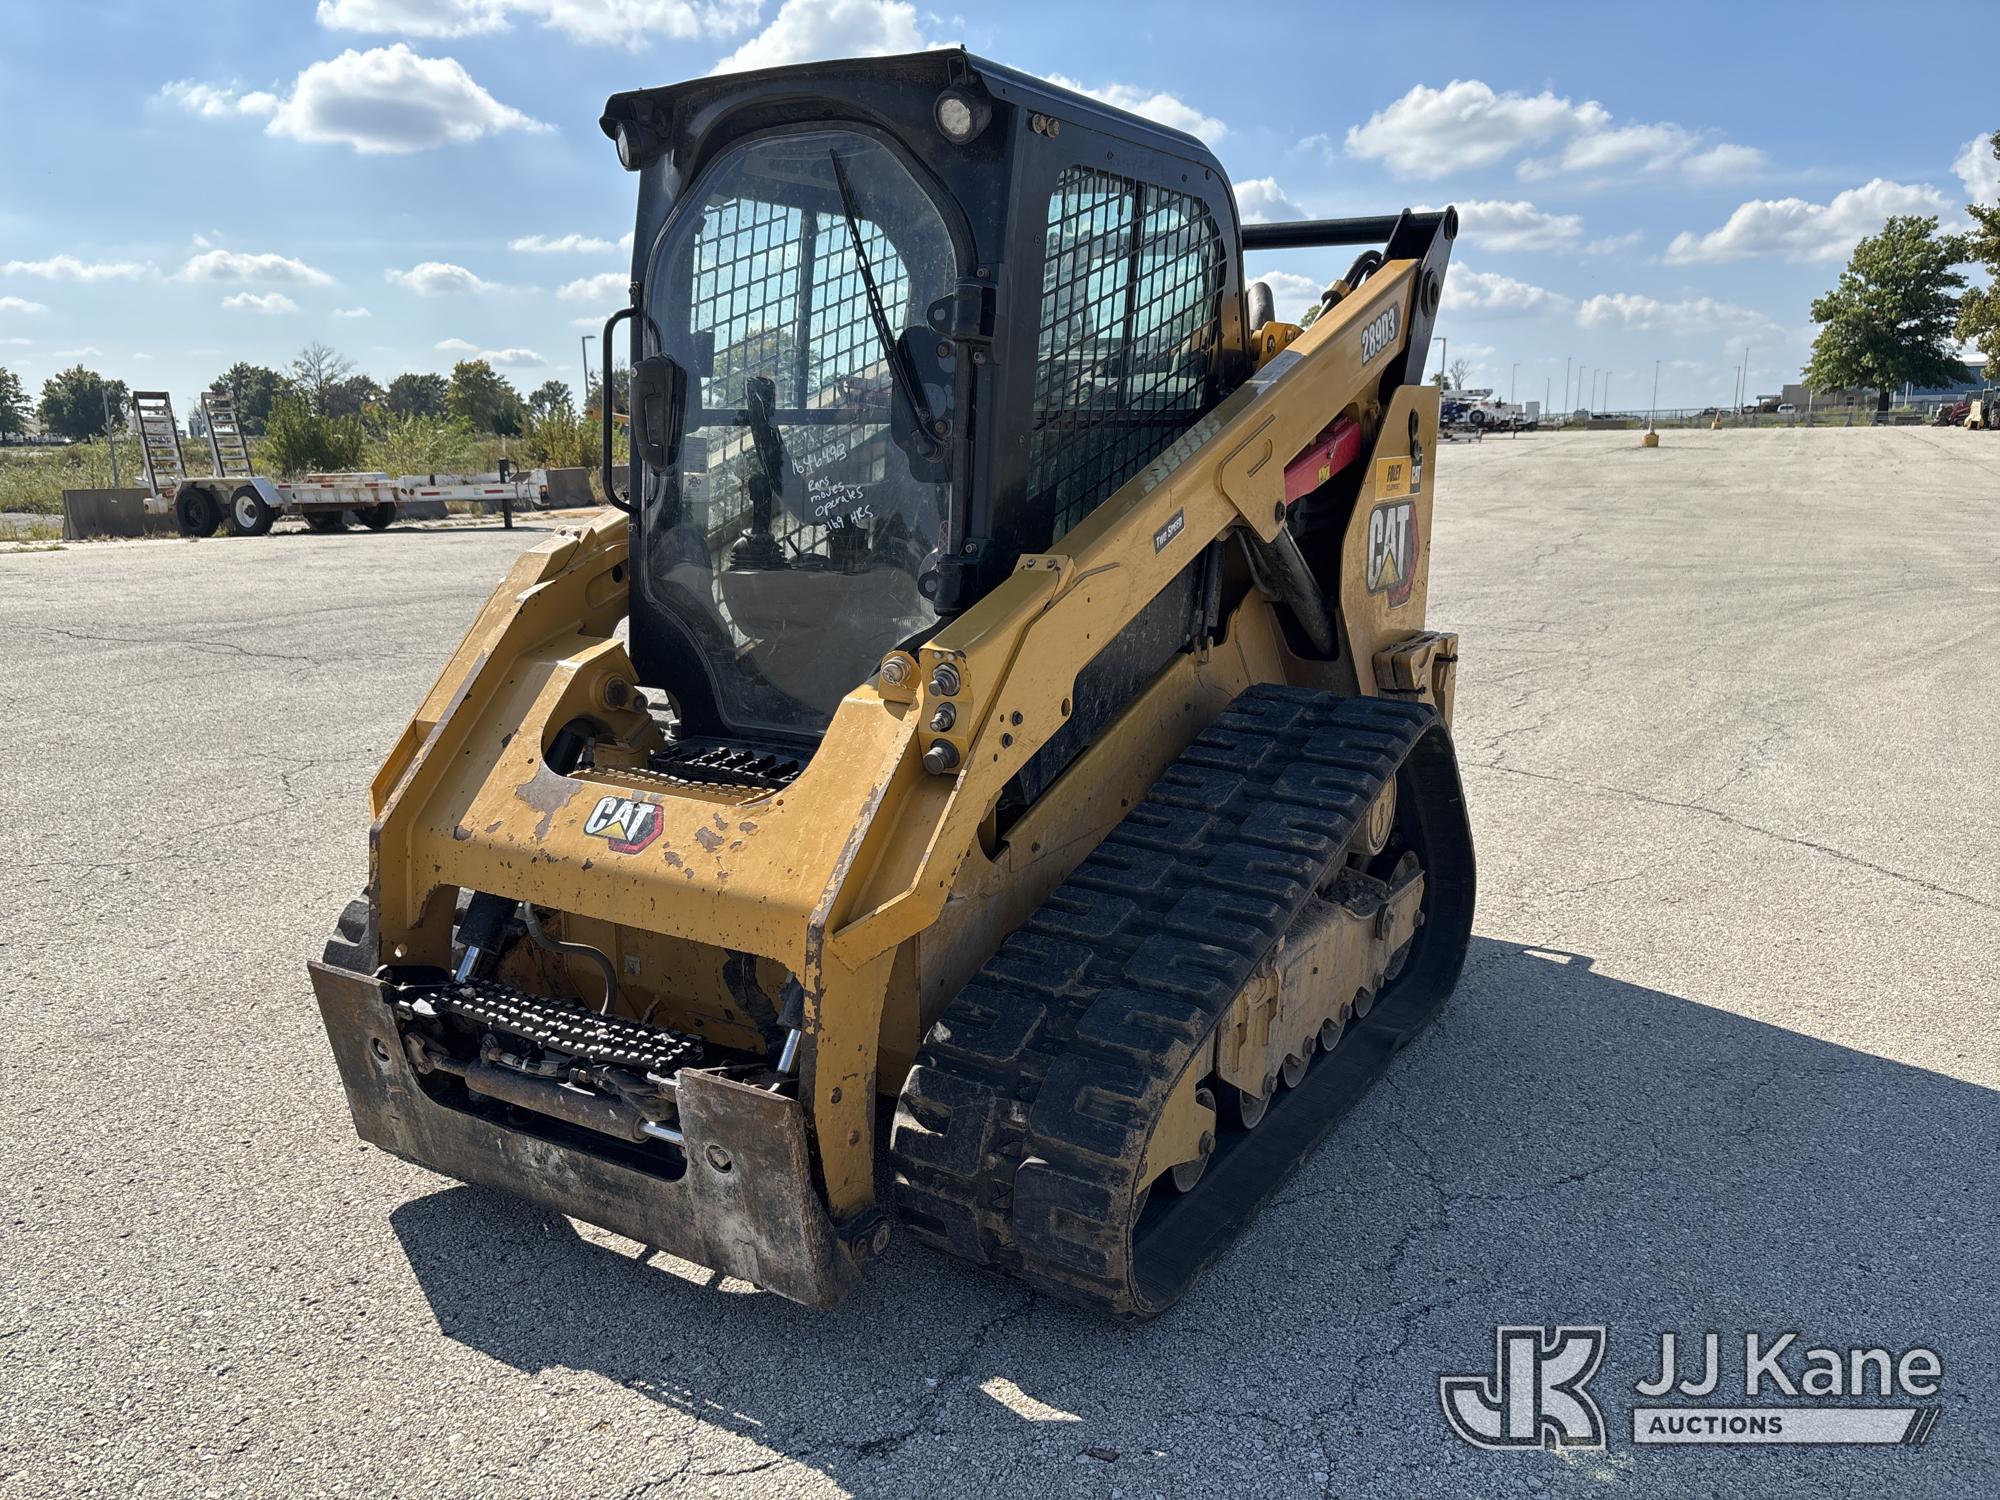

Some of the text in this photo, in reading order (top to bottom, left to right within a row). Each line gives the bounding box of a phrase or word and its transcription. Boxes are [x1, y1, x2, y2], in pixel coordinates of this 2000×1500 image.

[1361, 307, 1396, 364] 289D3
[850, 505, 874, 524] HRS
[1367, 505, 1410, 591] CAT
[585, 797, 656, 842] CAT
